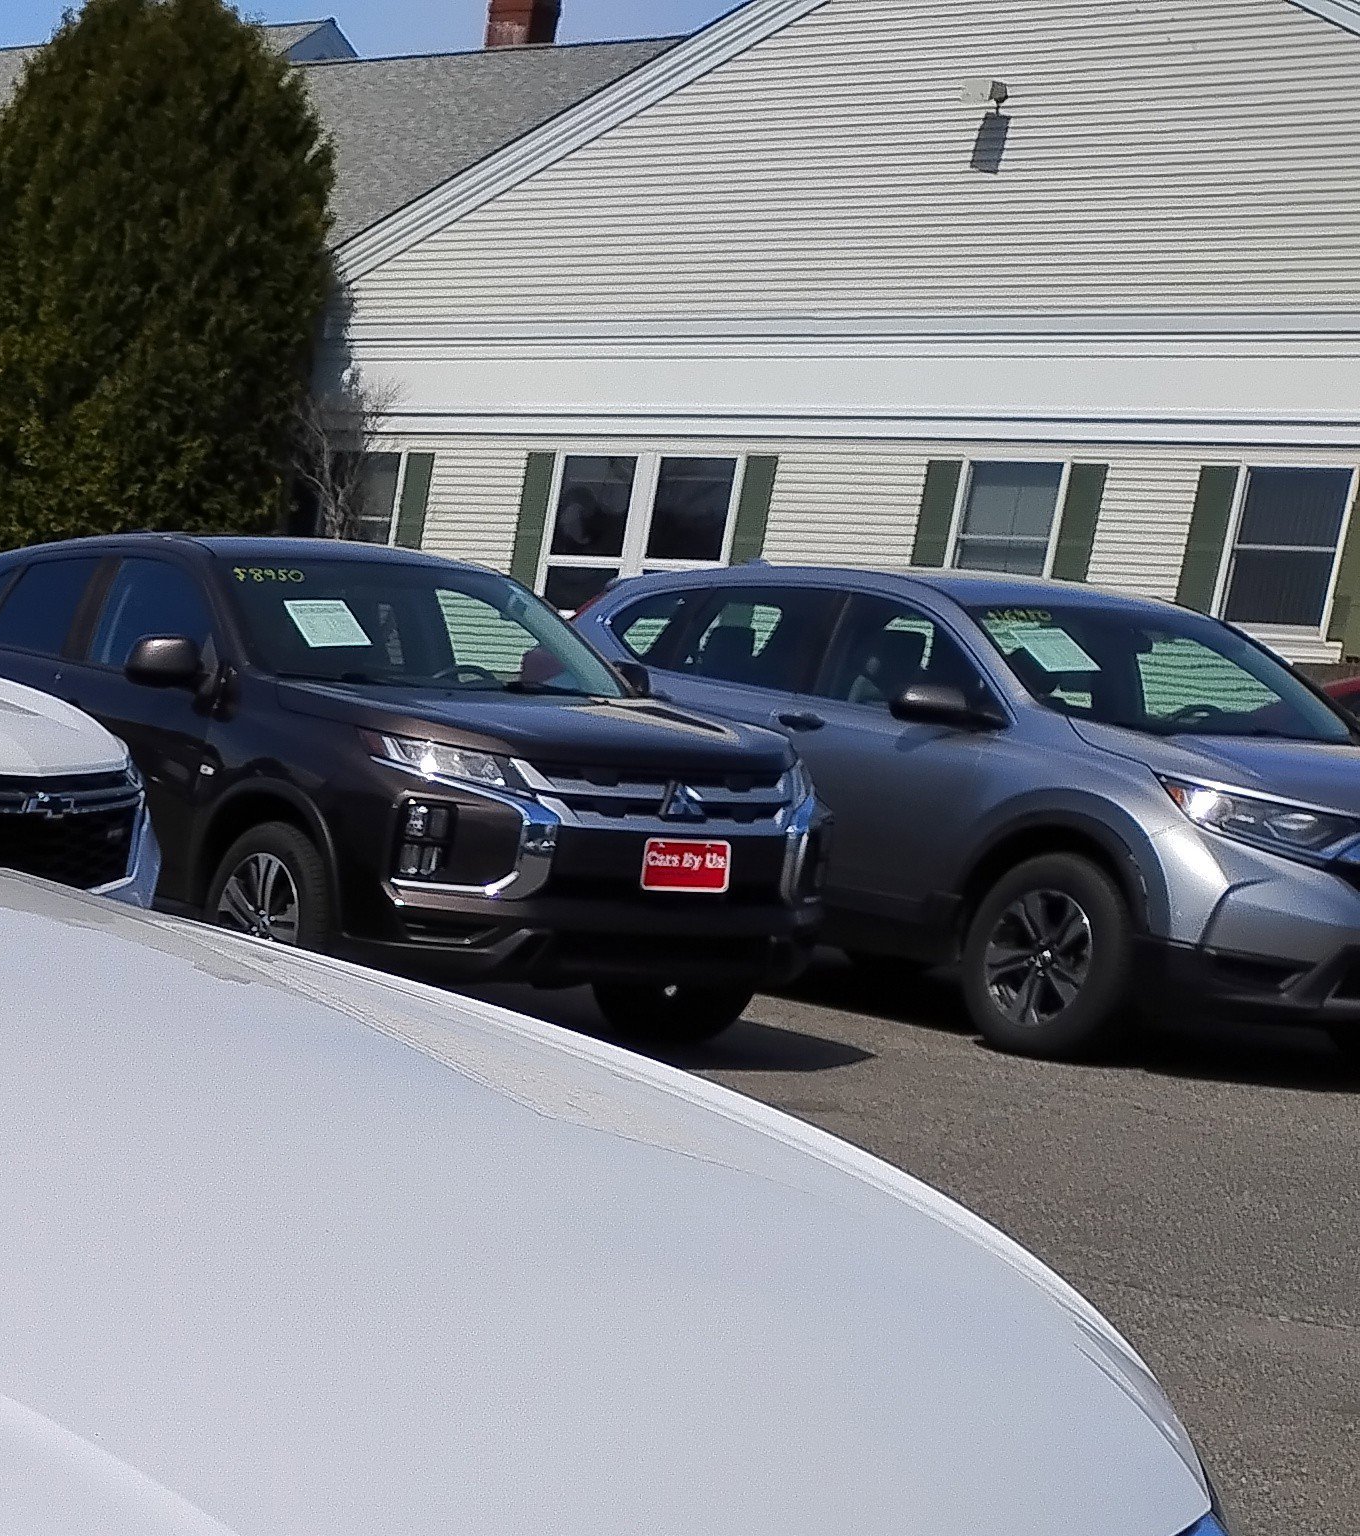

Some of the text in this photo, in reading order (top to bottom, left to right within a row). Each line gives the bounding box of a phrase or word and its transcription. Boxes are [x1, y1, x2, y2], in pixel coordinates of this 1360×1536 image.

[646, 850, 726, 871] Cars By Us
